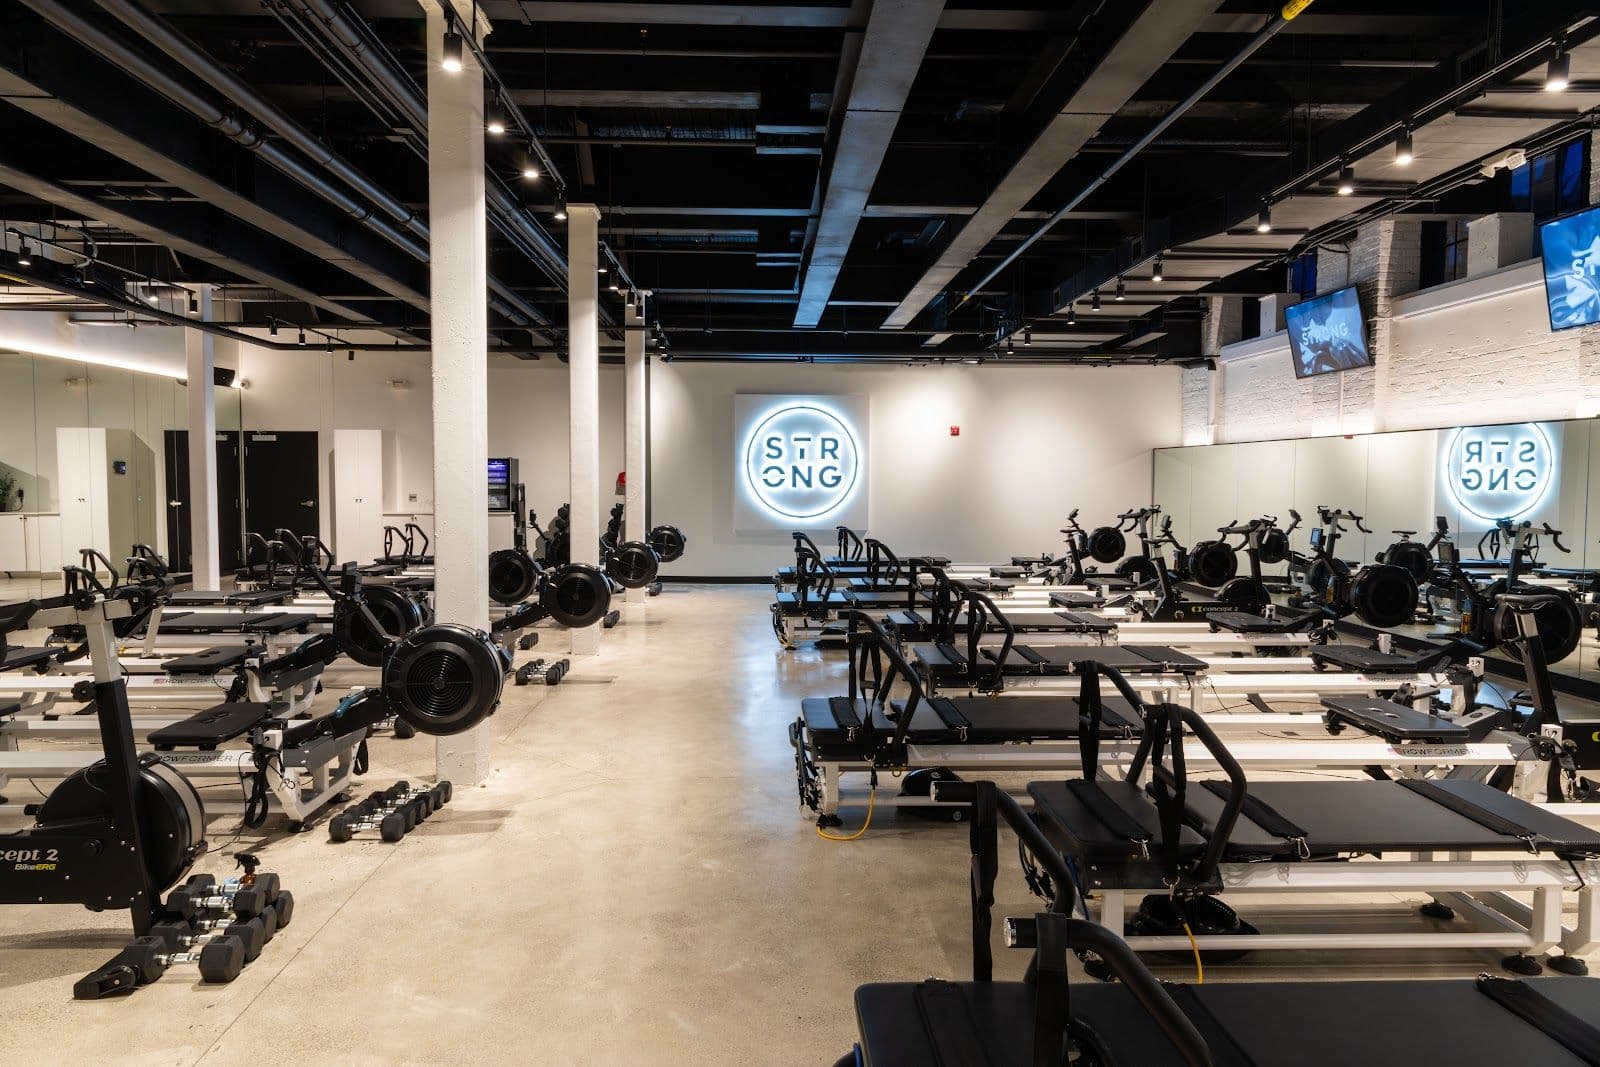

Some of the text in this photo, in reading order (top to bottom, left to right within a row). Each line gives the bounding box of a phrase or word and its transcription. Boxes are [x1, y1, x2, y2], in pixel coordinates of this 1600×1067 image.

[765, 436, 840, 460] STR
[762, 465, 842, 488] ONG
[160, 754, 234, 762] OWFORMER
[14, 863, 57, 871] BikeERG
